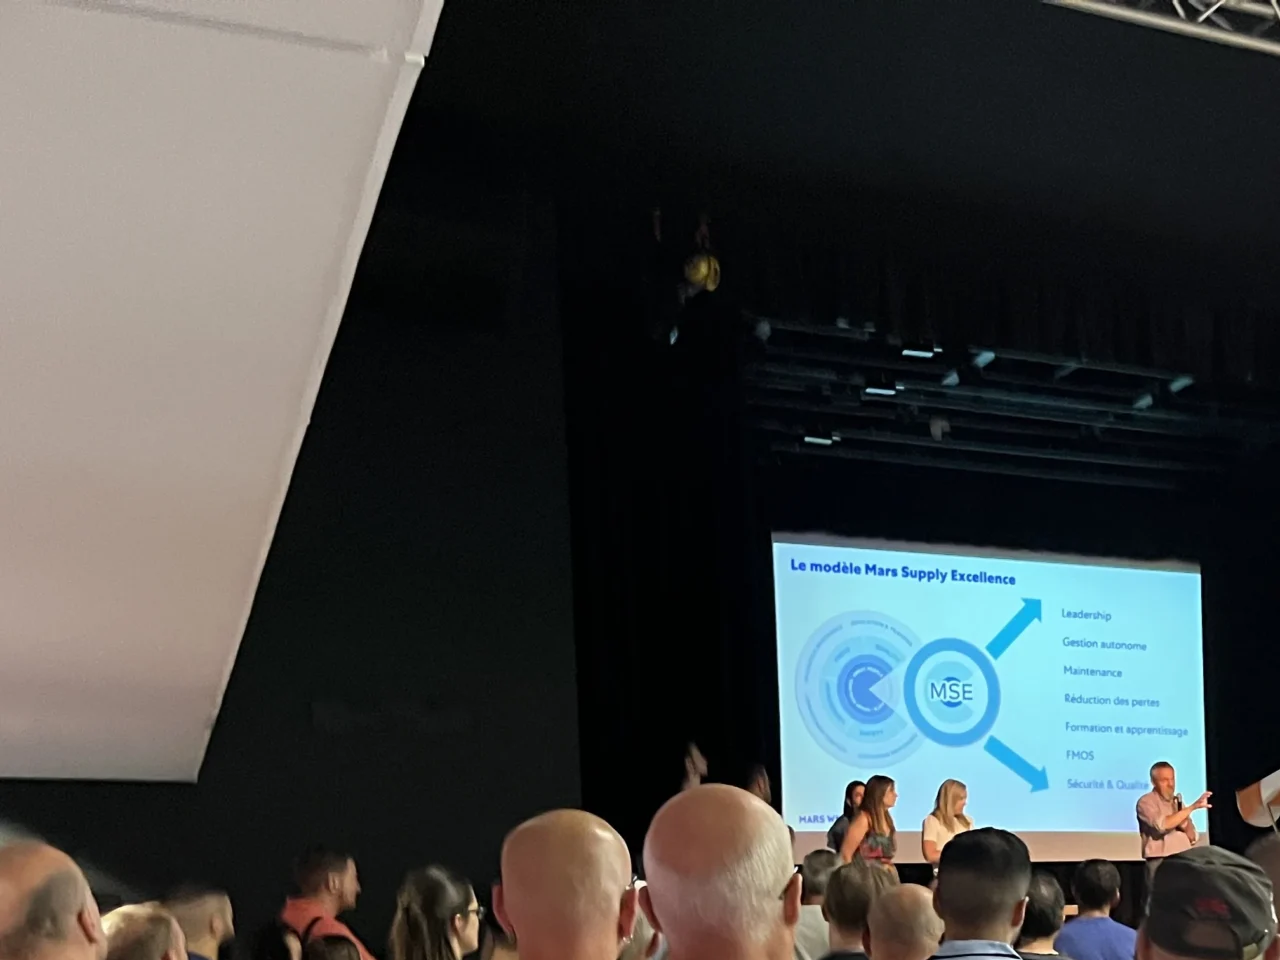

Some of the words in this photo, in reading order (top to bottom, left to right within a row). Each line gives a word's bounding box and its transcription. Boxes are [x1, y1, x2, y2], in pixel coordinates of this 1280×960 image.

[790, 558, 806, 571] Le
[810, 561, 861, 575] modèle
[864, 563, 898, 577] Mars
[901, 566, 948, 583] Supply
[951, 569, 1016, 585] Excellence
[1061, 608, 1112, 622] Leadership
[1062, 636, 1098, 649] Gestion
[1100, 640, 1147, 651] autonome
[1063, 665, 1122, 678] Maintenance
[930, 682, 974, 701] MSE
[1064, 693, 1112, 705] Réduction
[1113, 695, 1130, 706] des
[1131, 698, 1160, 707] pertes
[1065, 721, 1112, 734] Formation
[1114, 725, 1124, 734] et
[1125, 726, 1189, 737] apprentissage
[1066, 749, 1095, 761] FMOS
[1067, 778, 1105, 790] Sécurité
[1106, 779, 1115, 790] &
[799, 814, 825, 824] MARS
